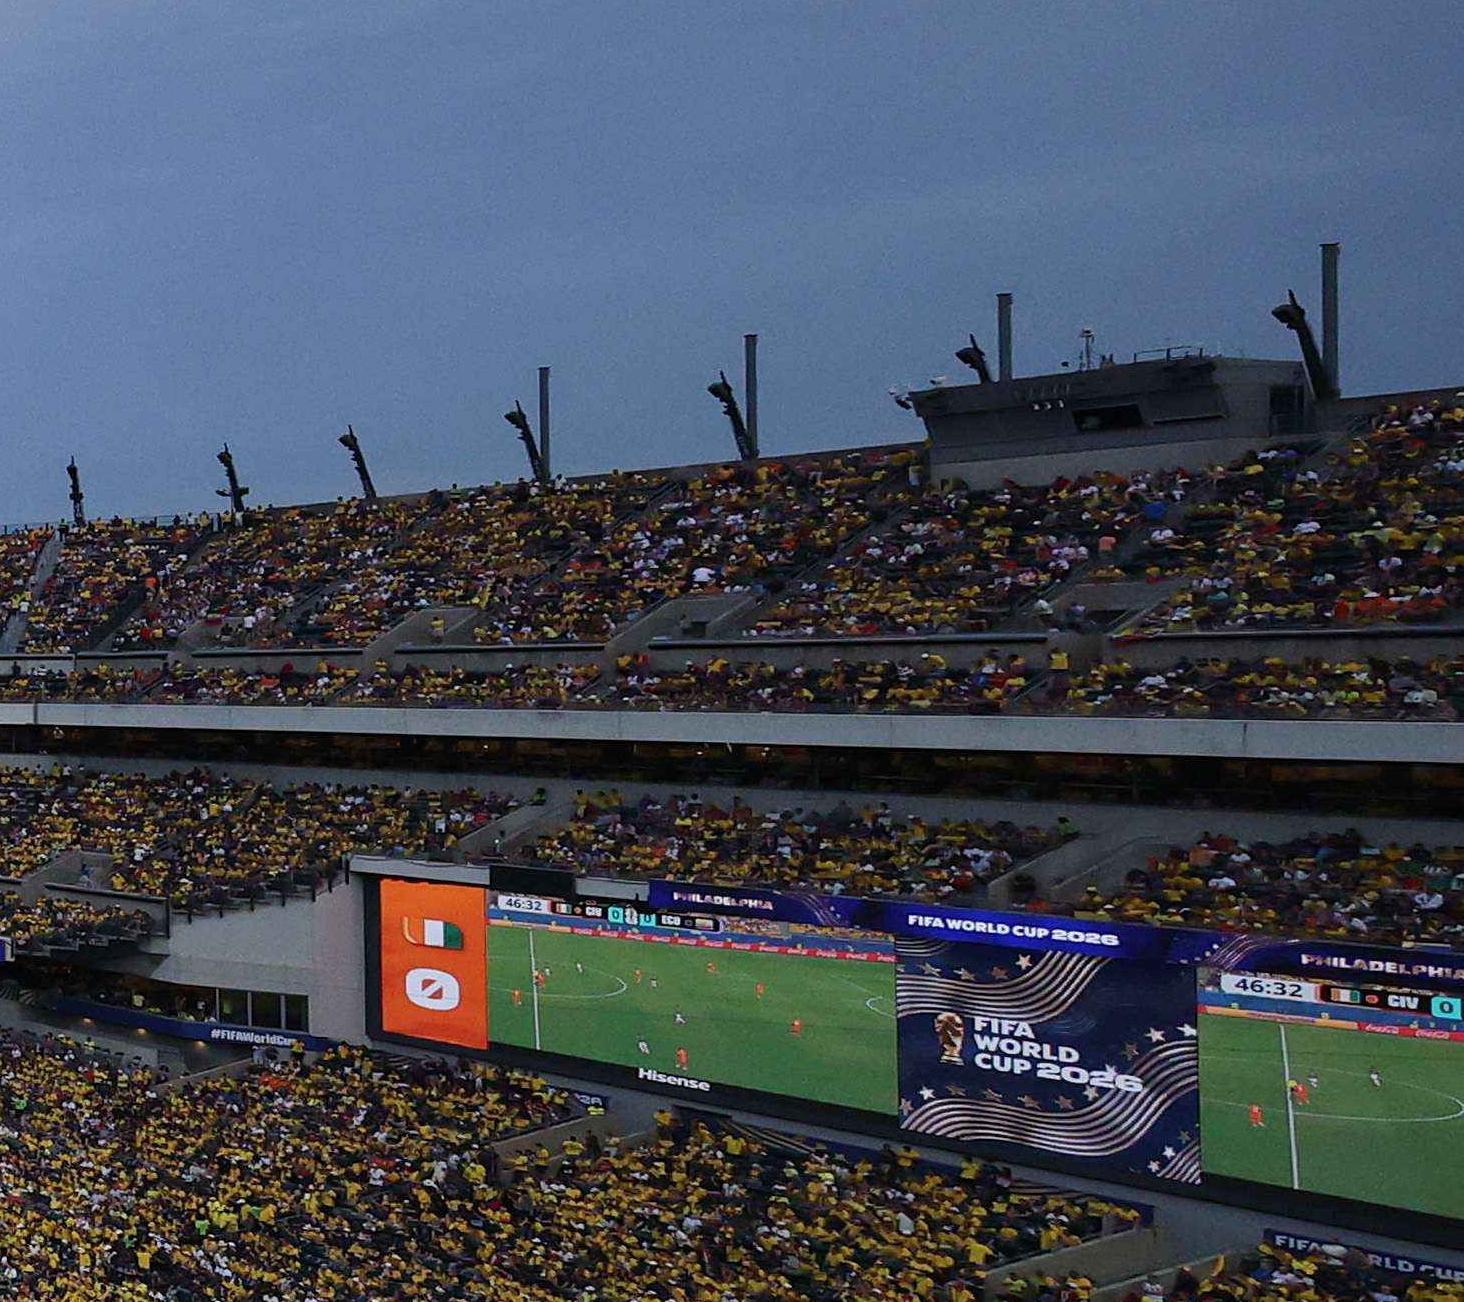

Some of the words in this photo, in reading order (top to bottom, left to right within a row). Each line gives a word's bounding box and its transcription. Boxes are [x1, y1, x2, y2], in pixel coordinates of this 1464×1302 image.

[505, 898, 542, 911] 46:32
[673, 892, 773, 911] PHILADELPHIA
[908, 915, 944, 929] FIFA
[946, 918, 1009, 934] WORLD
[1012, 925, 1049, 938] CUP
[1051, 929, 1120, 946] 2026
[1235, 977, 1303, 998] 46:32
[211, 1028, 298, 1047] #FIFAWorldCu
[973, 1016, 1035, 1039] FIFA
[973, 1033, 1080, 1063] WORLD
[637, 1068, 711, 1092] Hisense
[975, 1053, 1032, 1074] CUP
[1037, 1063, 1144, 1093] 2026
